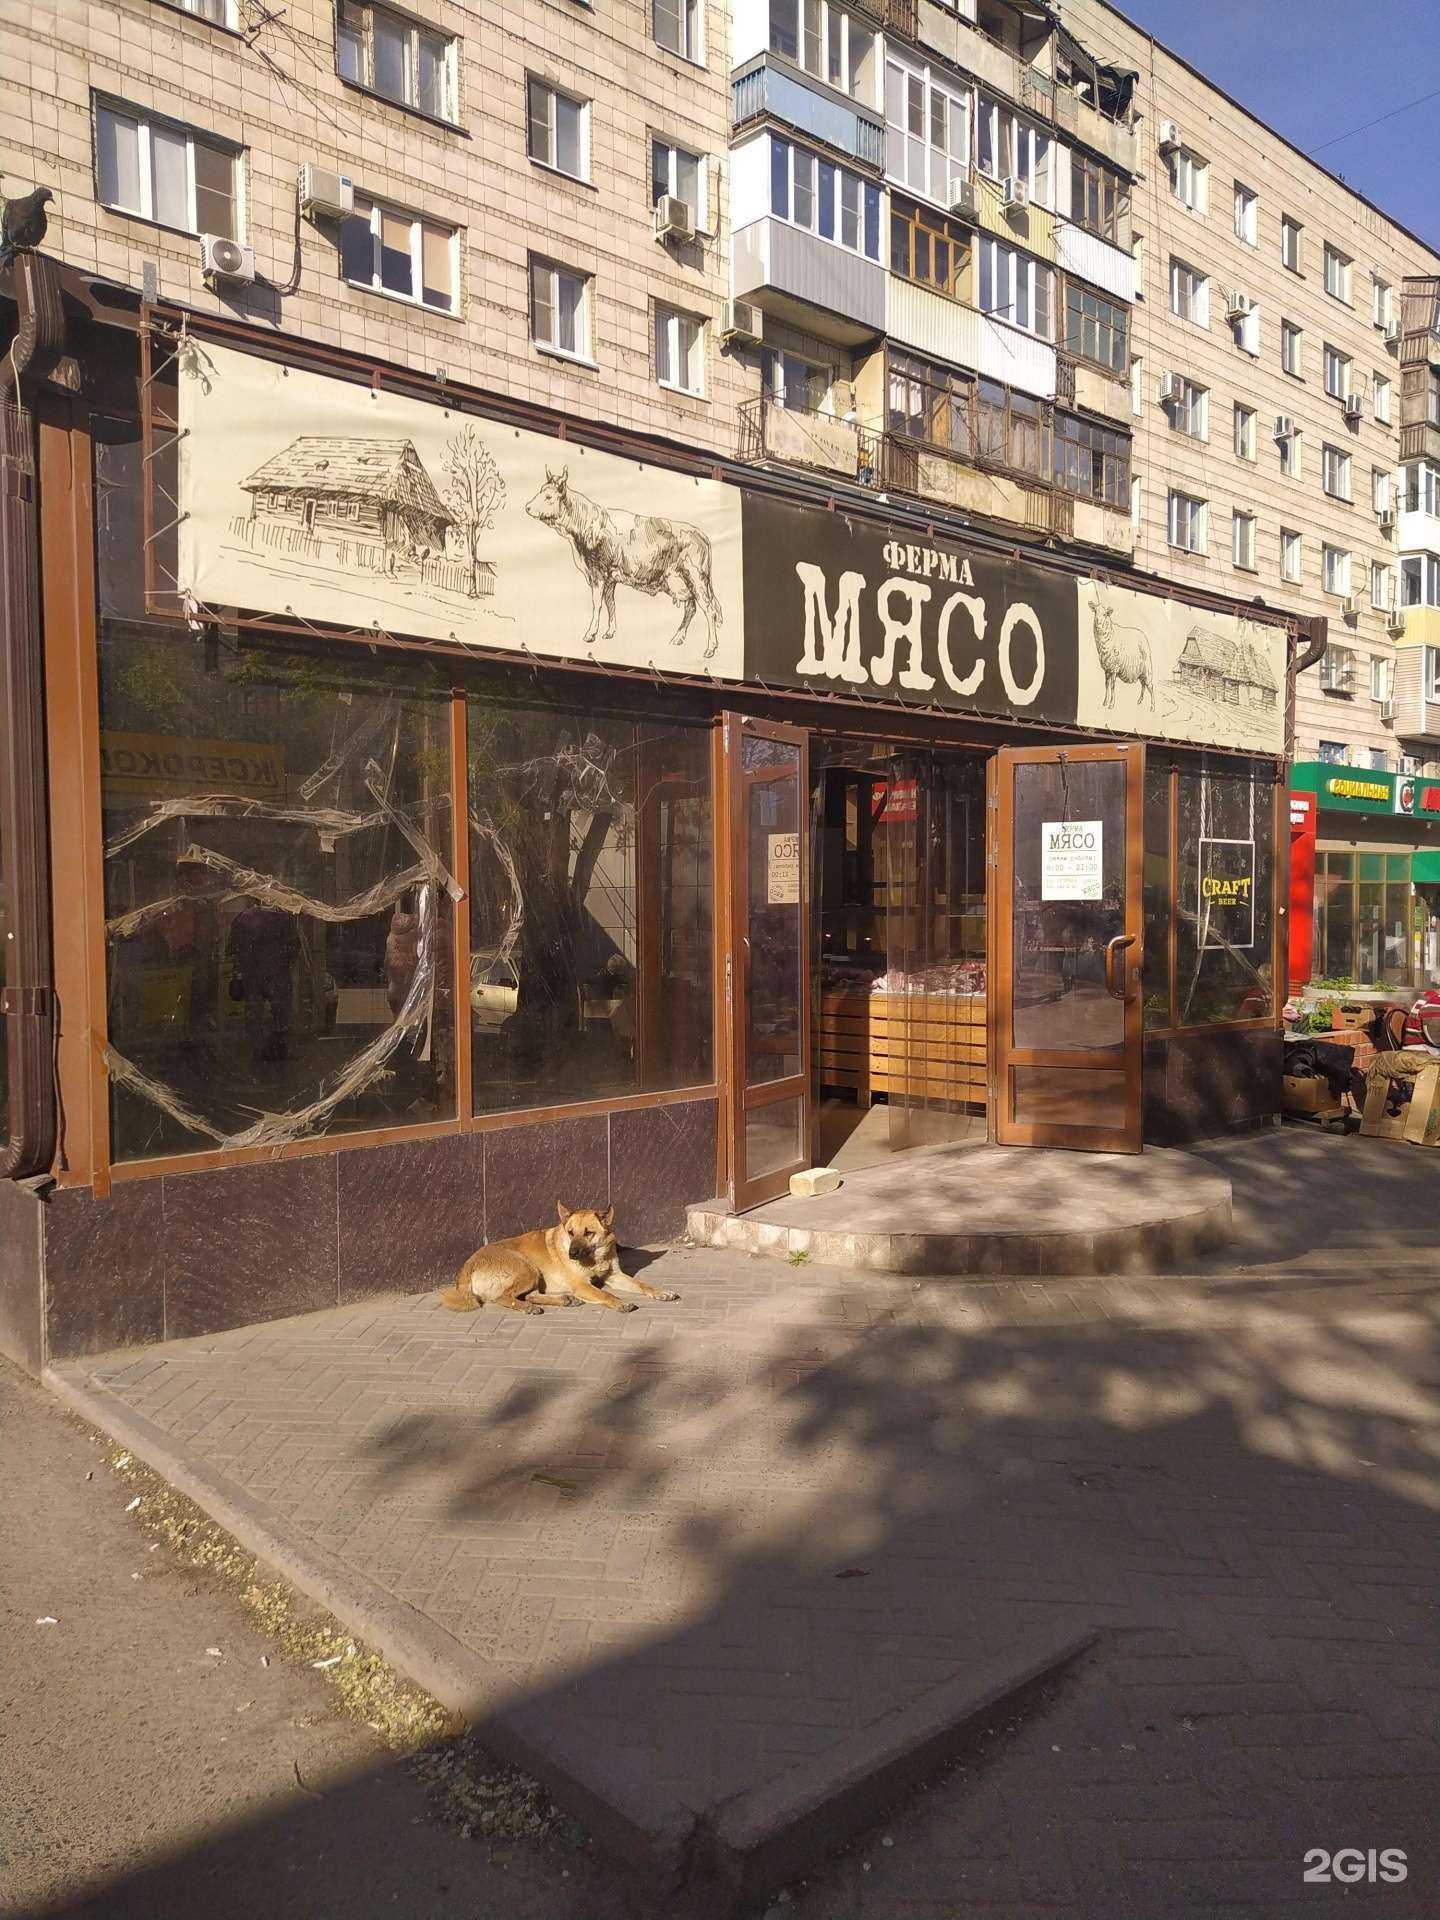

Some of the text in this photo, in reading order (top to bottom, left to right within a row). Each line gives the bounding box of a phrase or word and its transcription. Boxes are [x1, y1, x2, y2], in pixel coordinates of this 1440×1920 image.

[883, 541, 975, 587] ФЕРМА
[795, 561, 1045, 706] МЯСО
[1049, 833, 1095, 849] МЯСО
[1202, 876, 1251, 898] CRAFT
[1218, 898, 1237, 906] BEER
